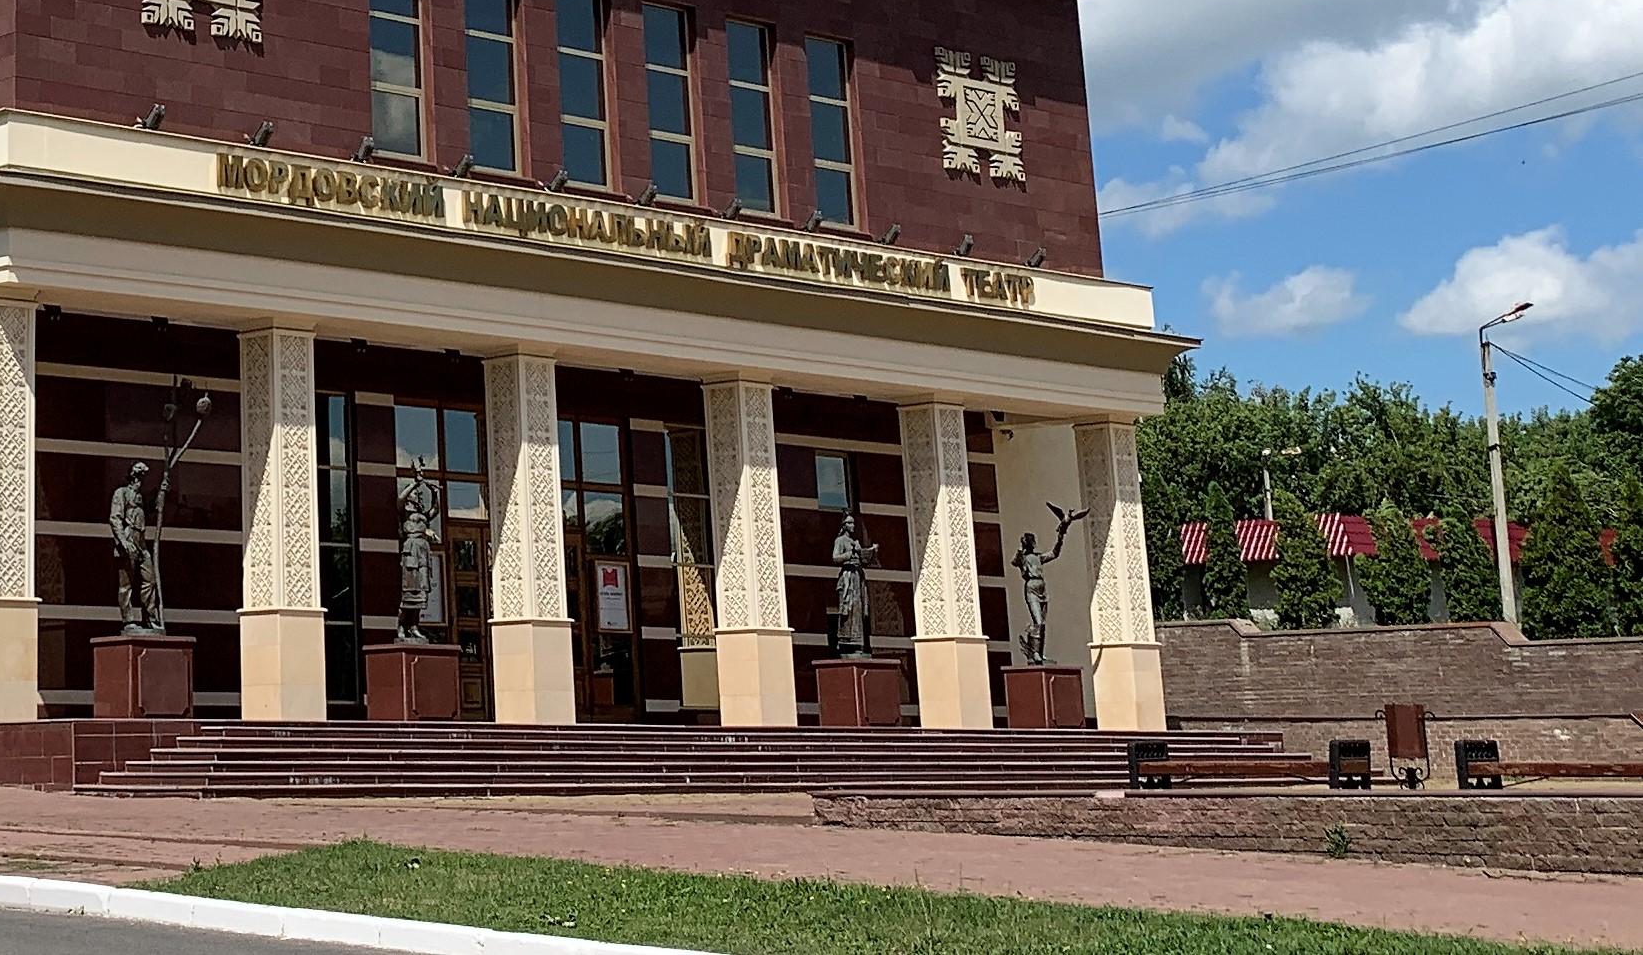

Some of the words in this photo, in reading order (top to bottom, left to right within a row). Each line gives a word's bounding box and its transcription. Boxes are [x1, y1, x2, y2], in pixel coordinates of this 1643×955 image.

[216, 152, 446, 219] МОРДОВСКИЙ
[461, 189, 713, 258] НАЦИОНАЛЬНЫЙ
[726, 230, 952, 293] ДРАМАТИЧЕСКИЙ
[960, 267, 1035, 305] ТЕАТР
